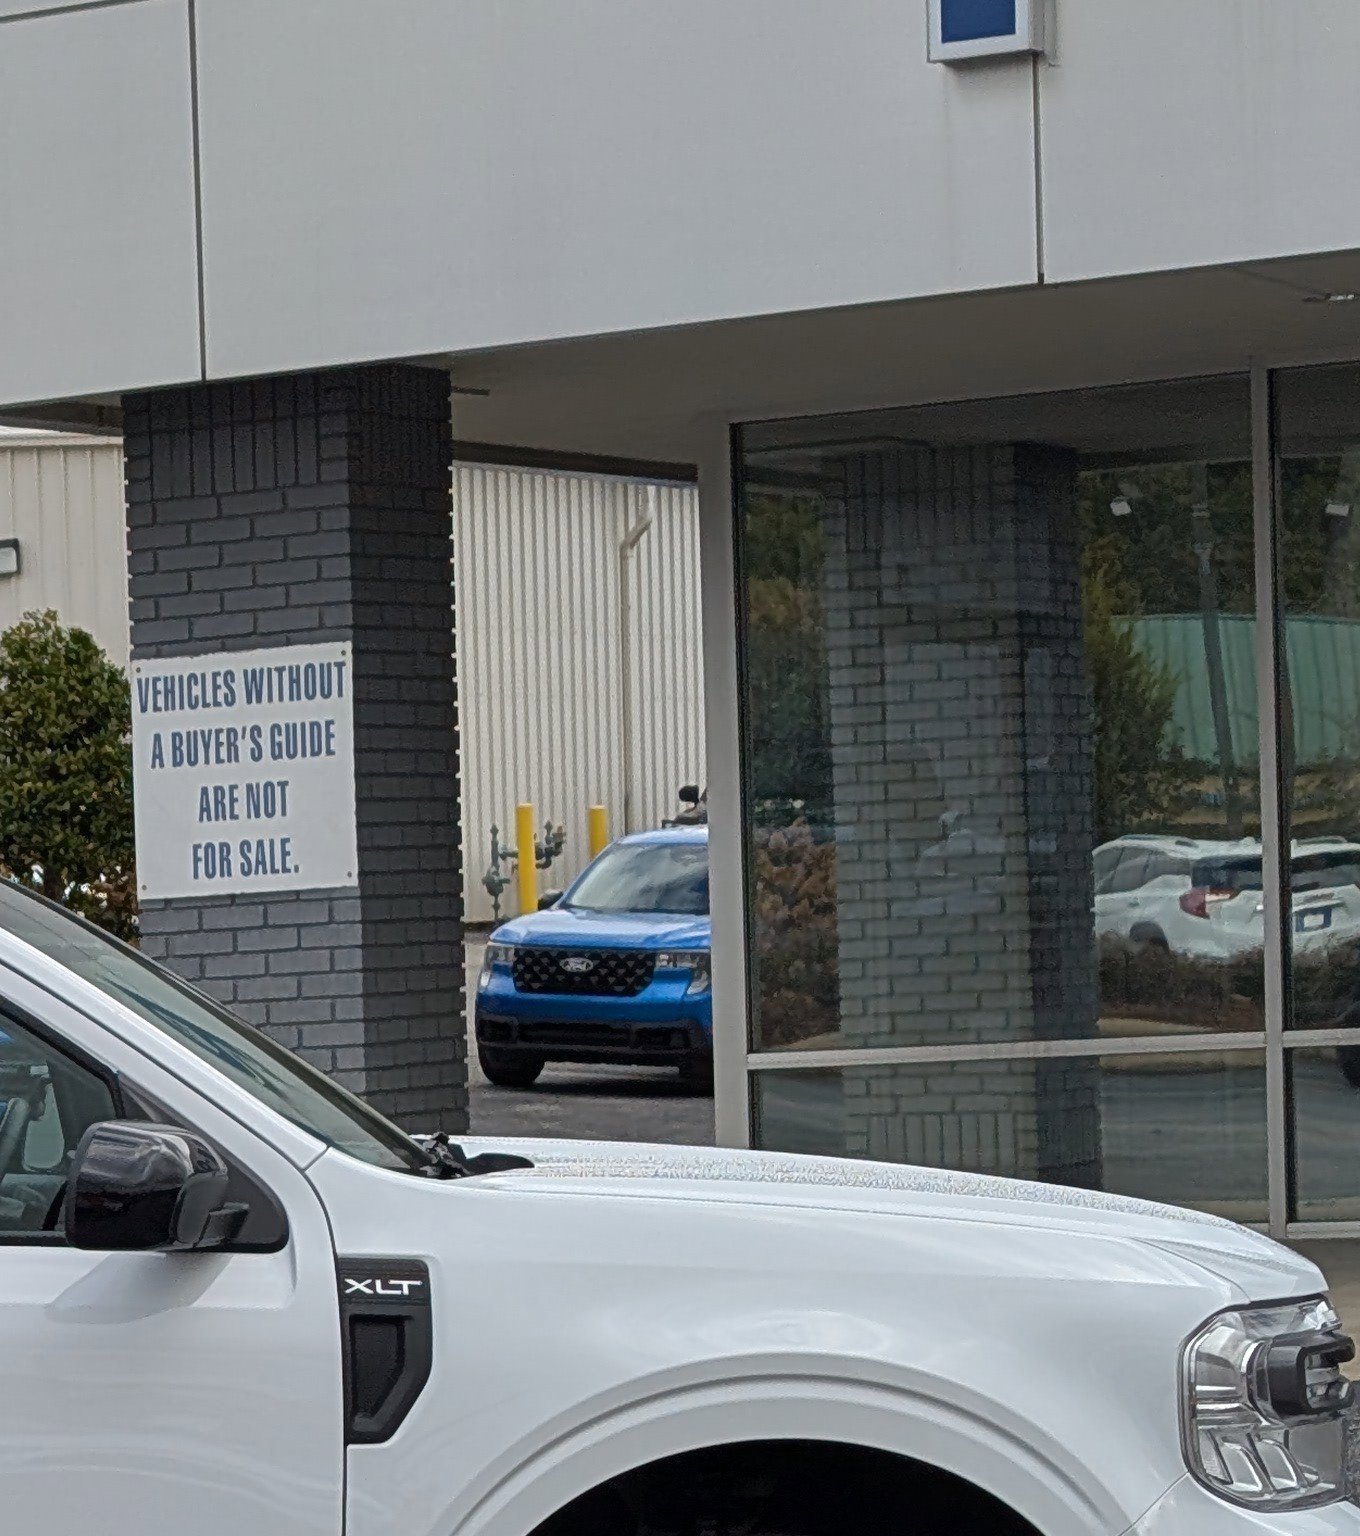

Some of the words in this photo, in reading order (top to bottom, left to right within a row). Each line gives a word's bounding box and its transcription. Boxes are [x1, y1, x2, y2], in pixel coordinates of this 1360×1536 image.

[137, 670, 236, 713] VEHICLES
[243, 661, 346, 705] WITHOUT
[151, 733, 165, 769] A
[171, 724, 262, 767] BUYER'S
[270, 719, 336, 761] GUIDE
[198, 784, 239, 822] ARE
[246, 780, 289, 818] NOT
[192, 842, 232, 880] FOR
[239, 837, 300, 877] SALE.
[344, 1278, 422, 1295] XLT
